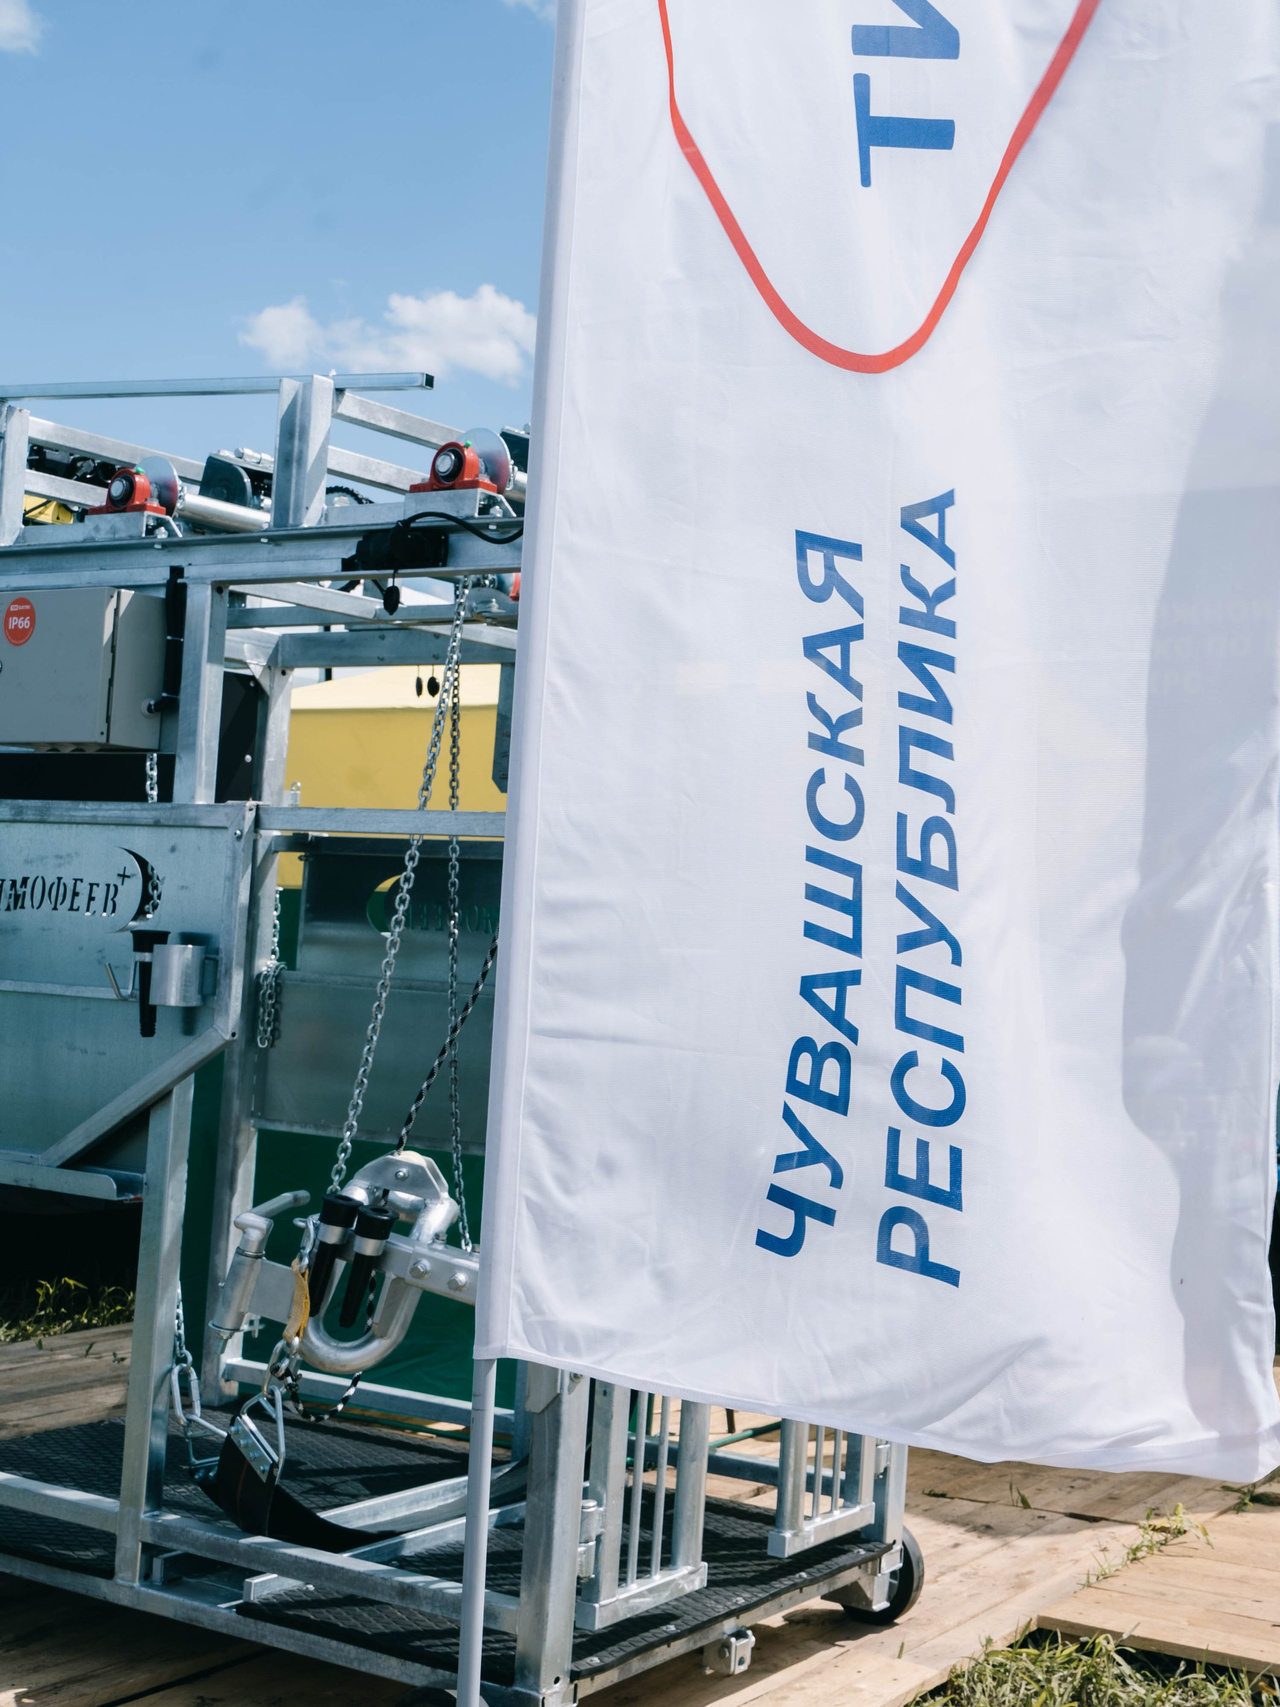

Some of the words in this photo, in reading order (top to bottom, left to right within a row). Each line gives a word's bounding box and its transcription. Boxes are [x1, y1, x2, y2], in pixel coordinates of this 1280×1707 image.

[8, 616, 31, 630] IP66
[0, 875, 119, 917] МОФЕЕВ
[754, 528, 865, 1258] ЧУВАШСКАЯ
[876, 487, 966, 1288] РЕСПУБЛИКА
